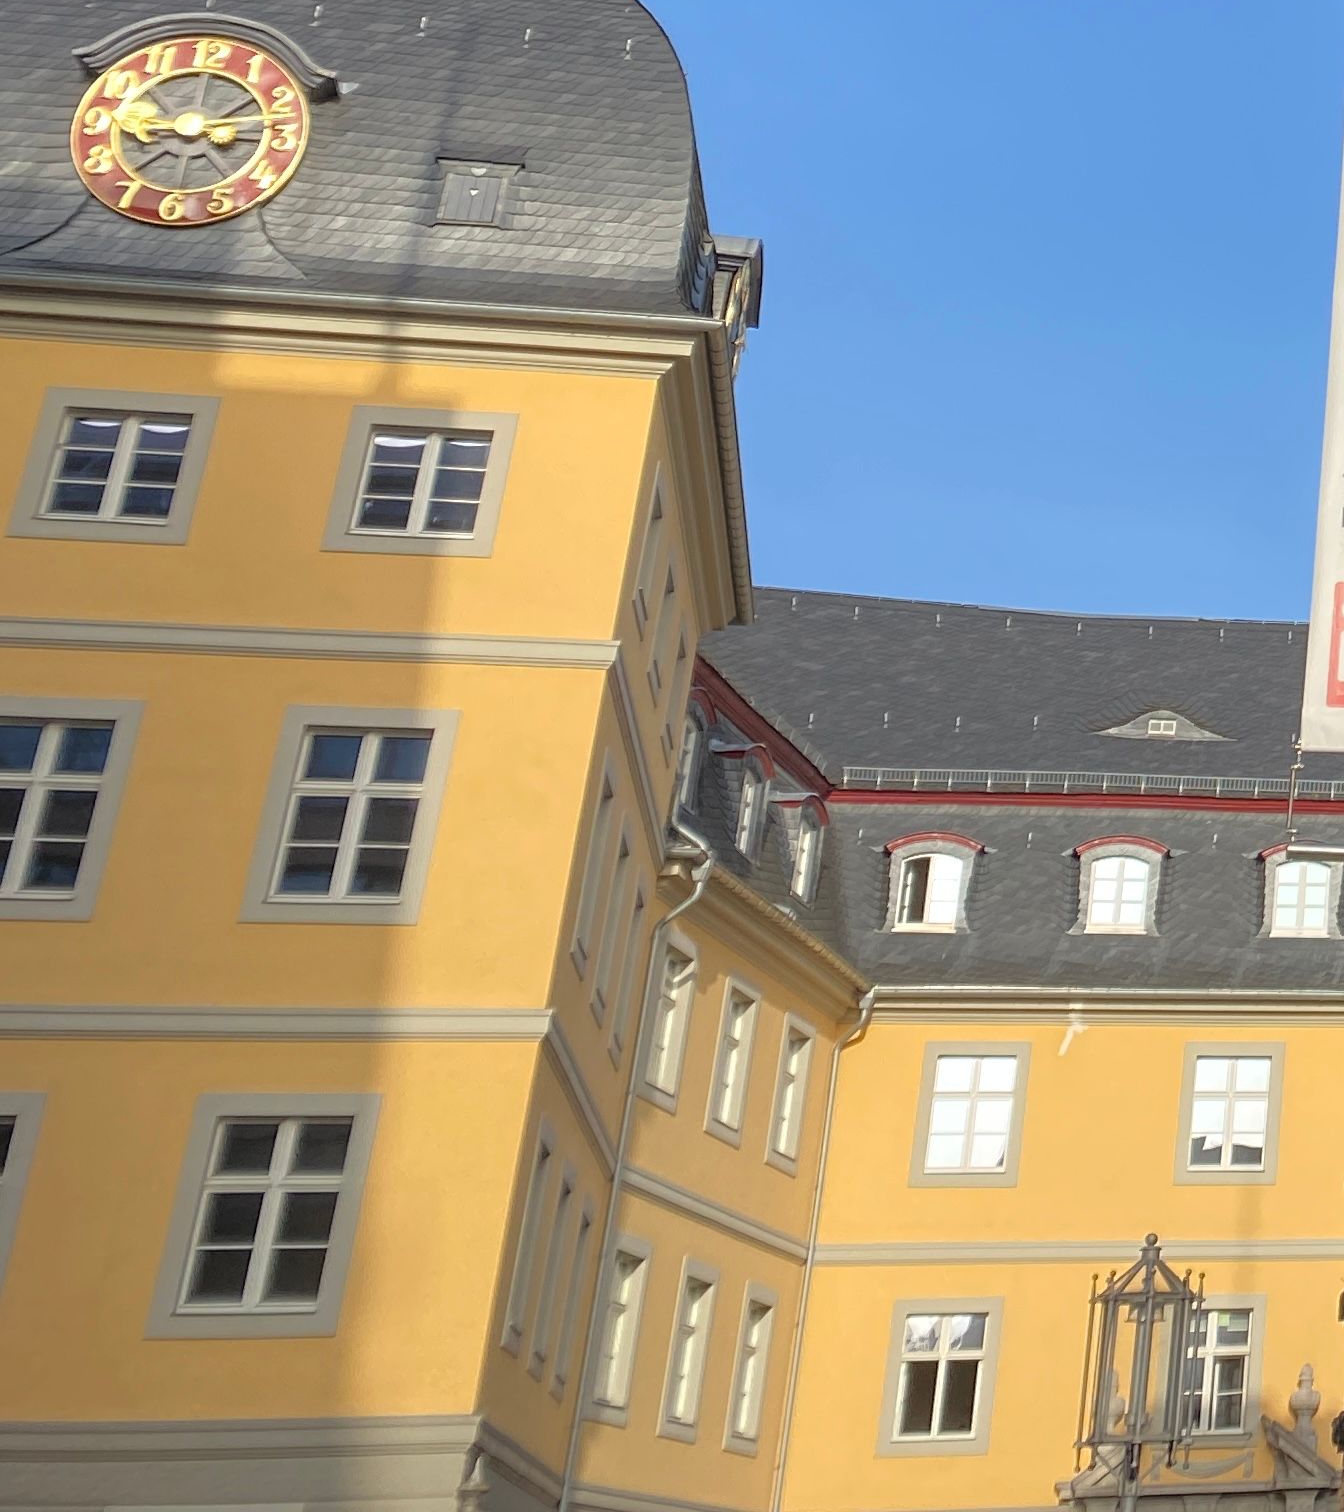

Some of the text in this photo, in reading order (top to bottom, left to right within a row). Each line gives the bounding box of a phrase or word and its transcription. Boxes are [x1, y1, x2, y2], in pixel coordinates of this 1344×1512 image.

[144, 45, 178, 73] 11
[192, 39, 233, 68] 12
[246, 53, 264, 84] 1
[102, 70, 141, 99] 10
[271, 86, 297, 116] 2
[83, 106, 112, 136] 9
[270, 123, 298, 151] 3
[83, 144, 113, 174] 8
[249, 159, 277, 189] 4
[115, 180, 143, 209] 7
[158, 193, 186, 221] 6
[206, 187, 234, 215] 5
